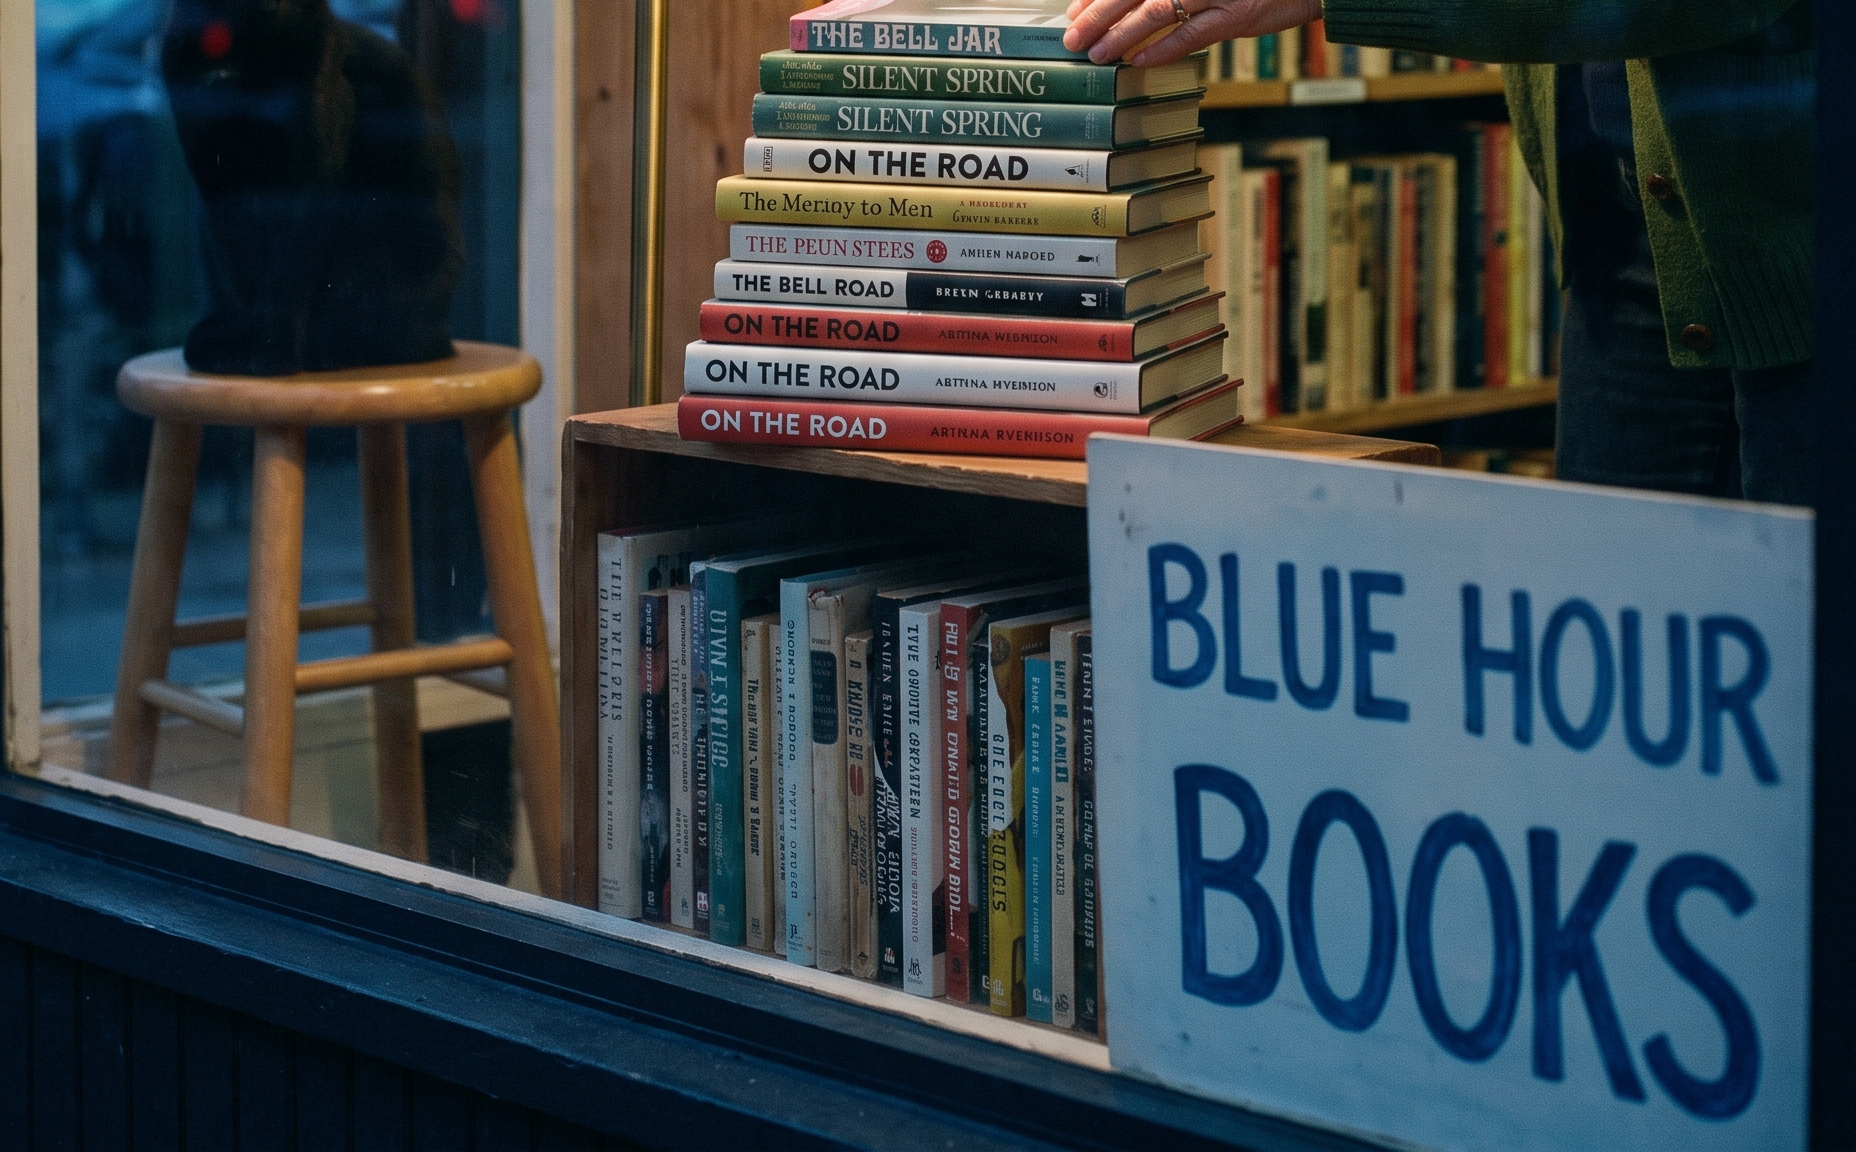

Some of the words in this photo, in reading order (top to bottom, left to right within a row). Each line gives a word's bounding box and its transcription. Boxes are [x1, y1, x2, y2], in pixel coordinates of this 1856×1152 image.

[811, 22, 863, 48] THE
[873, 24, 938, 51] BELL
[948, 26, 1003, 55] JAR
[842, 63, 938, 93] SILENT
[945, 67, 1046, 97] SPRING
[837, 105, 934, 135] SILENT
[941, 109, 1043, 139] SPRING
[808, 148, 856, 176] ON
[868, 150, 927, 178] THE
[937, 153, 1029, 181] ROAD
[739, 191, 777, 211] The
[861, 199, 882, 216] to
[888, 197, 933, 218] Men
[745, 235, 787, 254] THE
[732, 274, 771, 292] THE
[779, 276, 827, 295] BELL
[835, 278, 895, 298] ROAD
[724, 313, 763, 335] ON
[771, 315, 819, 338] THE
[827, 318, 900, 342] ROAD
[705, 359, 748, 384] ON
[757, 361, 810, 387] THE
[819, 364, 900, 391] ROAD
[701, 409, 741, 432] ON
[750, 411, 800, 435] THE
[809, 414, 887, 440] ROAD
[1147, 542, 1411, 724] BLUE
[1460, 582, 1782, 787] HOUR
[1173, 762, 1763, 1122] BOOKS
